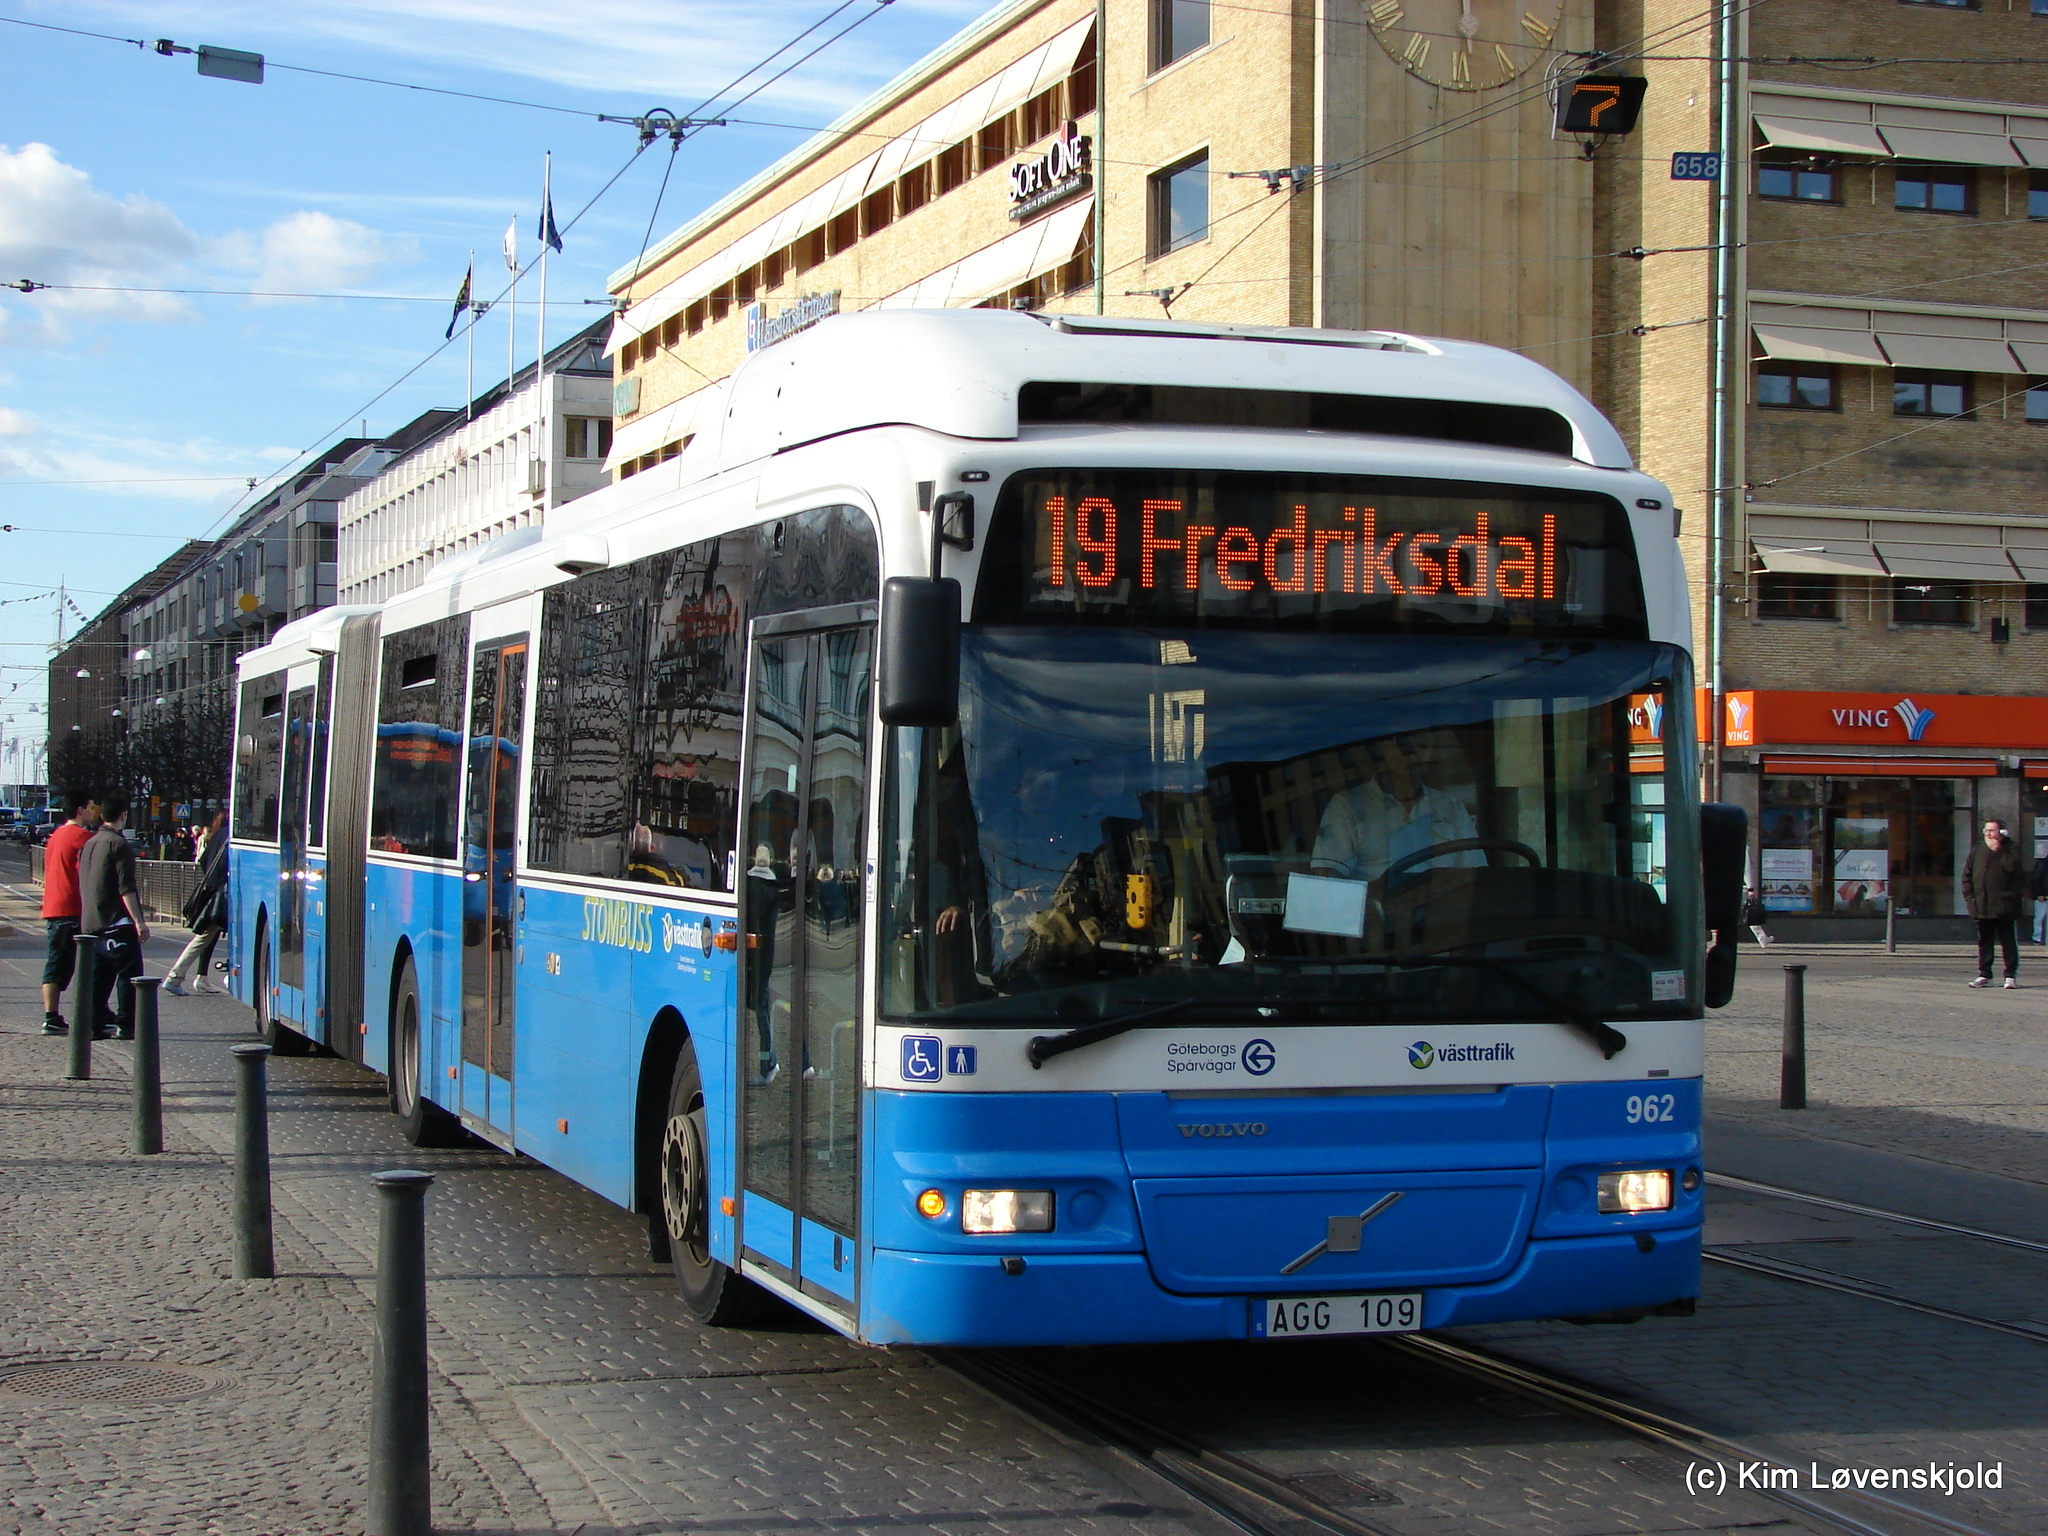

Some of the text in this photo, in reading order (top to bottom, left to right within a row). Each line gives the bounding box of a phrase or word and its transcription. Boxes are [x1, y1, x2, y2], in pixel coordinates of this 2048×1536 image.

[1572, 84, 1620, 127] 7
[1008, 134, 1082, 203] SOFT ONE
[1673, 155, 1719, 178] 658
[1046, 496, 1556, 600] 19 Fredriksdal
[1831, 708, 1890, 728] VING
[1727, 730, 1750, 741] VING
[582, 895, 654, 954] STOMBUSS
[1167, 1042, 1237, 1058] Göteborgs
[1437, 1042, 1516, 1062] västtrafik
[1167, 1058, 1237, 1075] Spårvägar
[1626, 1093, 1675, 1124] 962
[1177, 1122, 1268, 1138] VOLVO
[1272, 1300, 1331, 1333] AGG
[1359, 1297, 1415, 1328] 109
